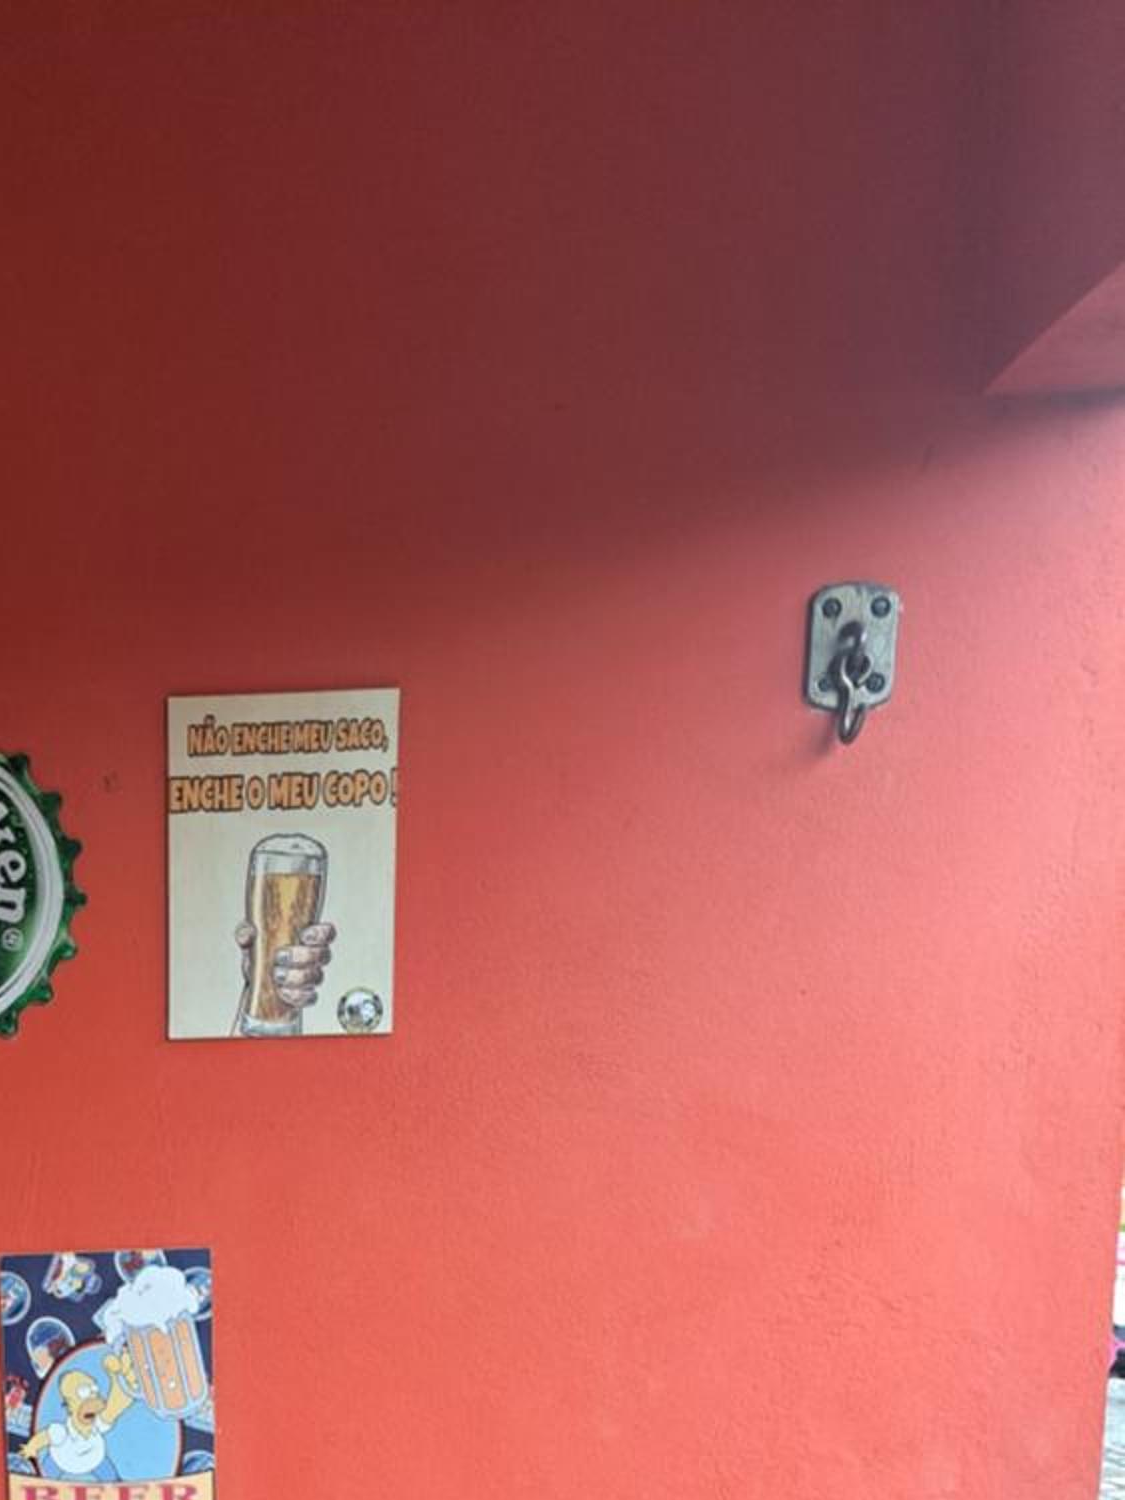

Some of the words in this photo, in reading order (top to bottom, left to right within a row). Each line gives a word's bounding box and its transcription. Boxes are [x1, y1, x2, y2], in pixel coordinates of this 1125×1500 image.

[187, 714, 229, 757] NÃO
[231, 722, 295, 756] ENCHE
[295, 719, 333, 753] MEU
[335, 717, 389, 753] SACO,
[168, 774, 244, 814] ENCHE
[246, 775, 266, 810] O
[267, 772, 321, 811] MEU
